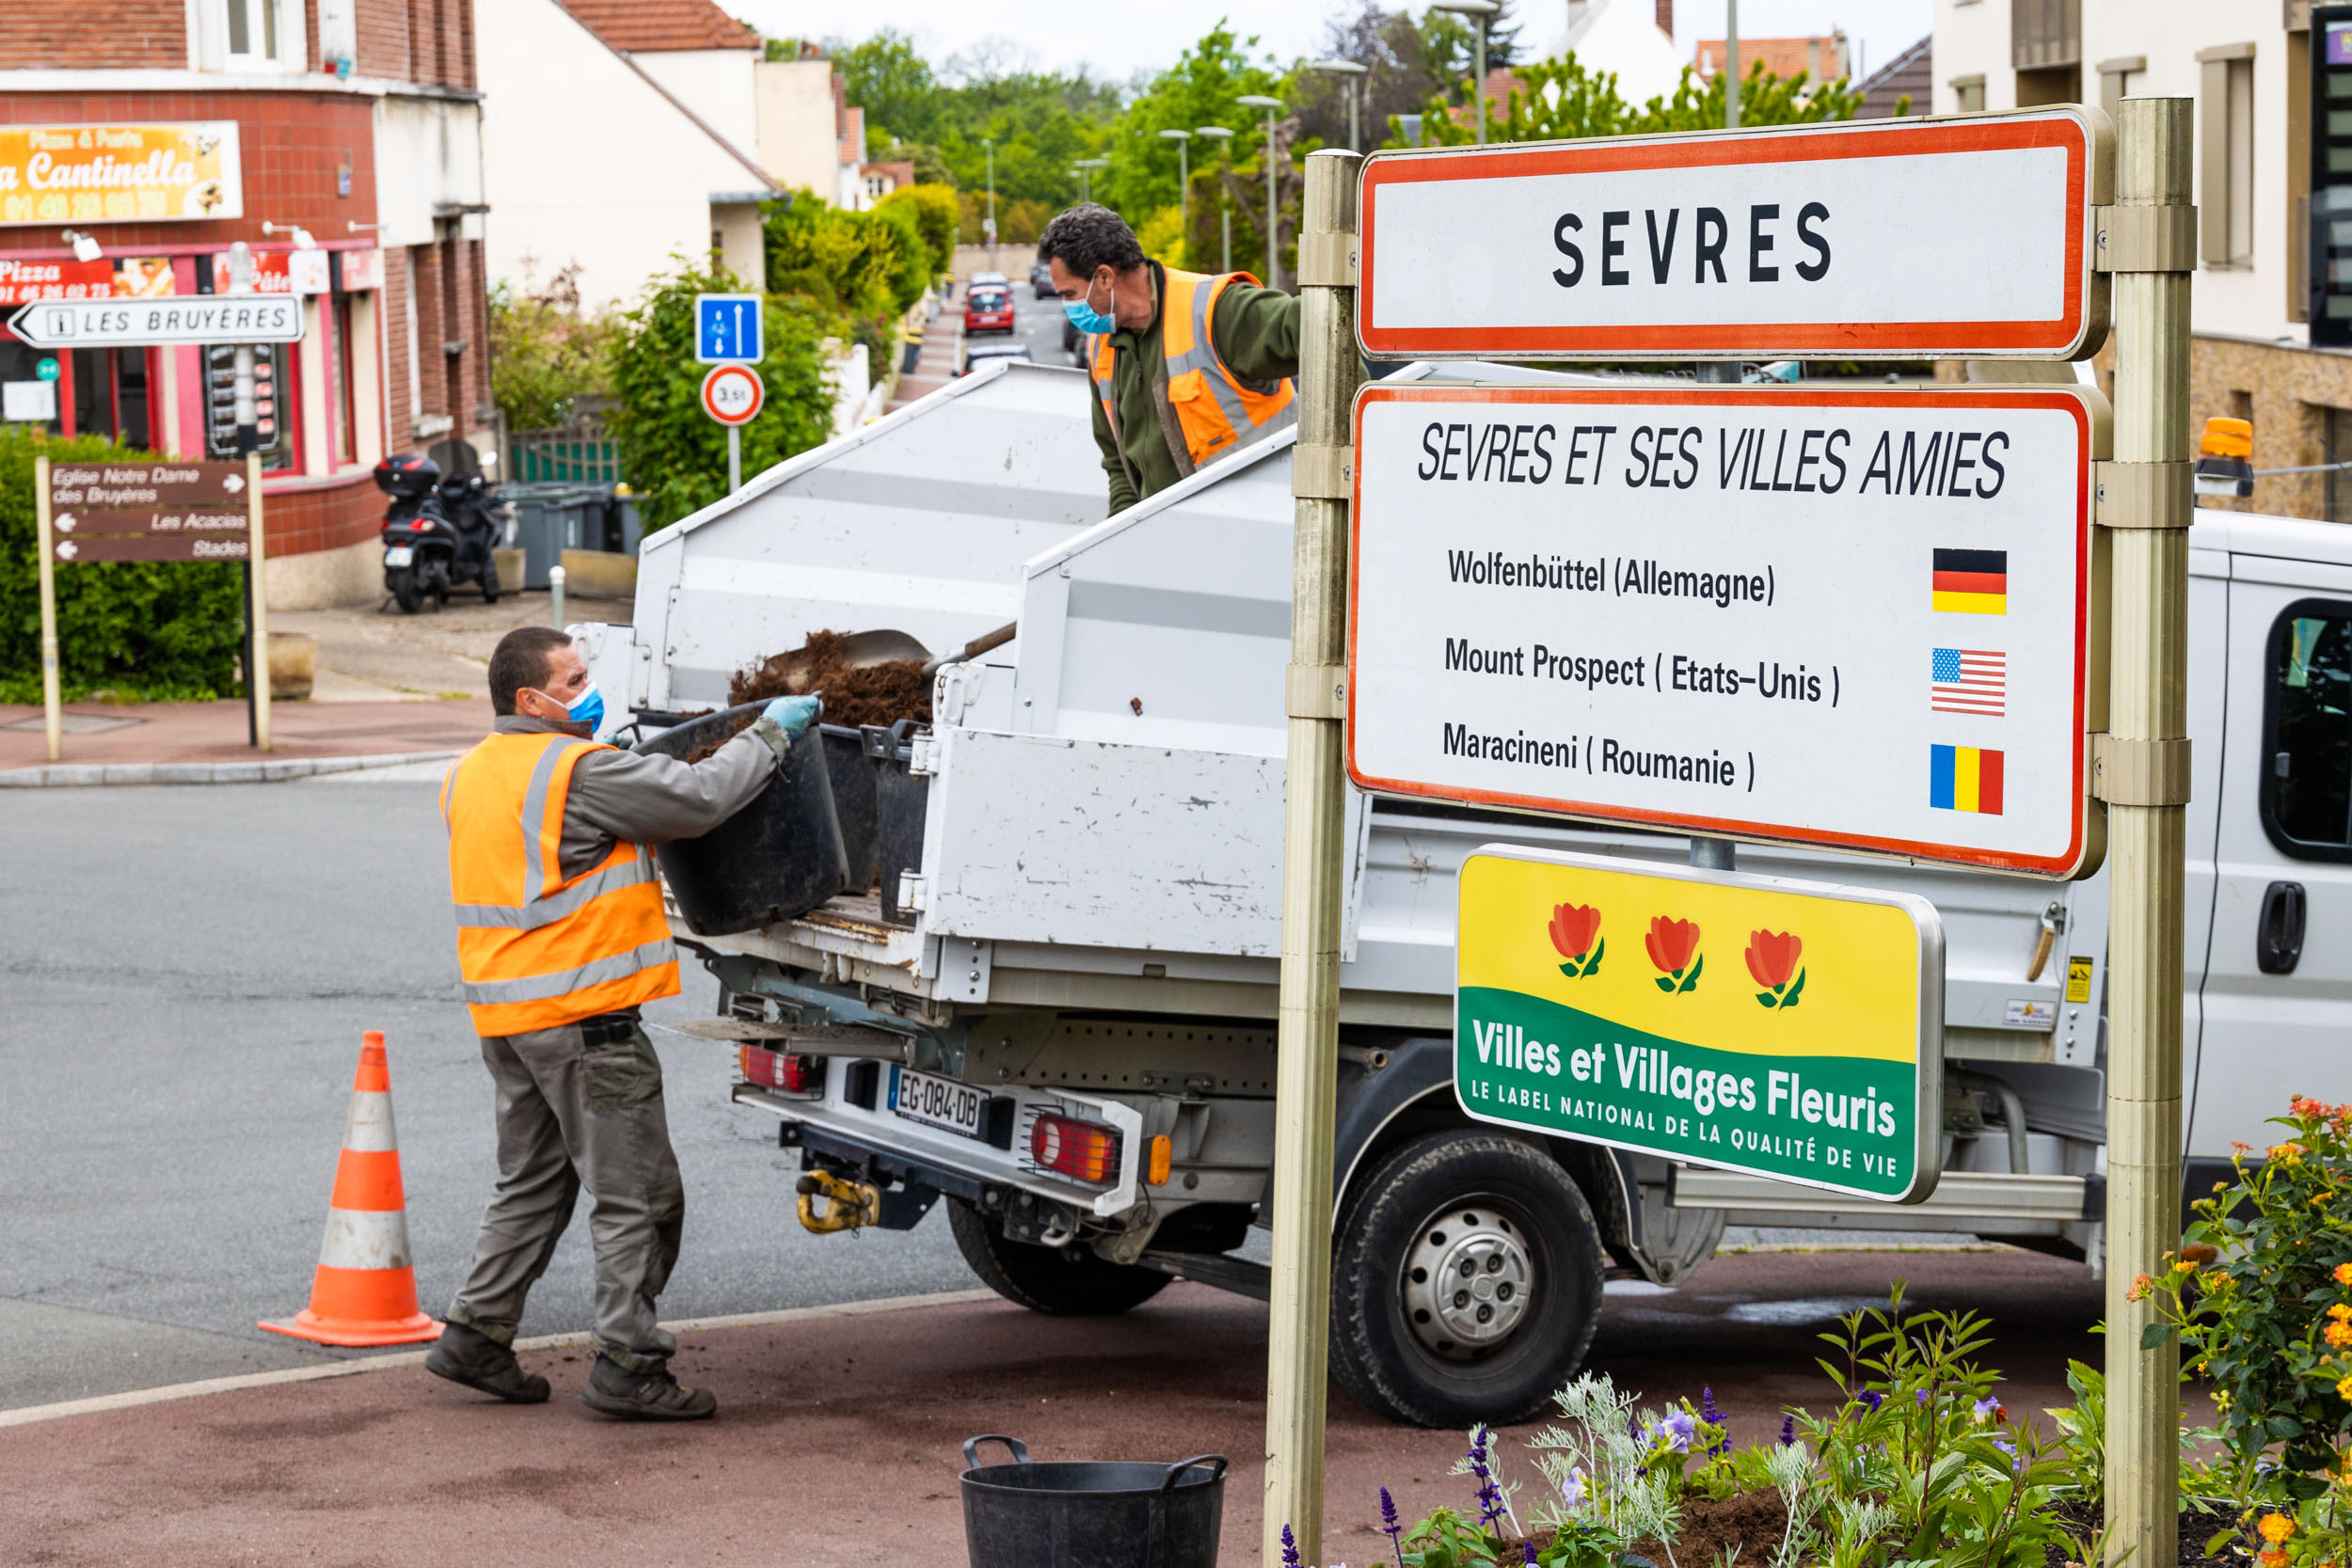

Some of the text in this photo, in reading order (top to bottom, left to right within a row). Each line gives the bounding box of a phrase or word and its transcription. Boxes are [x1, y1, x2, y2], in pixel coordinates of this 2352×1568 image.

[0, 149, 198, 189] a Cantinella
[1553, 202, 1831, 288] SEVRES
[0, 261, 61, 282] Pizza
[85, 311, 130, 333] LES
[148, 303, 286, 330] BRUYÈRES
[53, 467, 199, 487] Eglise Notre Dame
[1419, 422, 2010, 499] SEVRES ET SES VILLES AMIES
[53, 486, 157, 505] des Bruyères
[151, 513, 247, 530] Les Acacias
[192, 540, 248, 557] Stades
[1449, 550, 1774, 609] Wolfenbüttel (Allemagne)
[1446, 638, 1524, 678] Mount
[1534, 644, 1645, 691] Prospect
[1444, 722, 1578, 770] Maracineni
[899, 1073, 977, 1128] EG-084-DB
[1472, 1019, 1897, 1137] Villes et Villages Fleuris
[1471, 1079, 1897, 1178] LE LABEL NATIONAL DE LA QUALITÉ DE VIE
